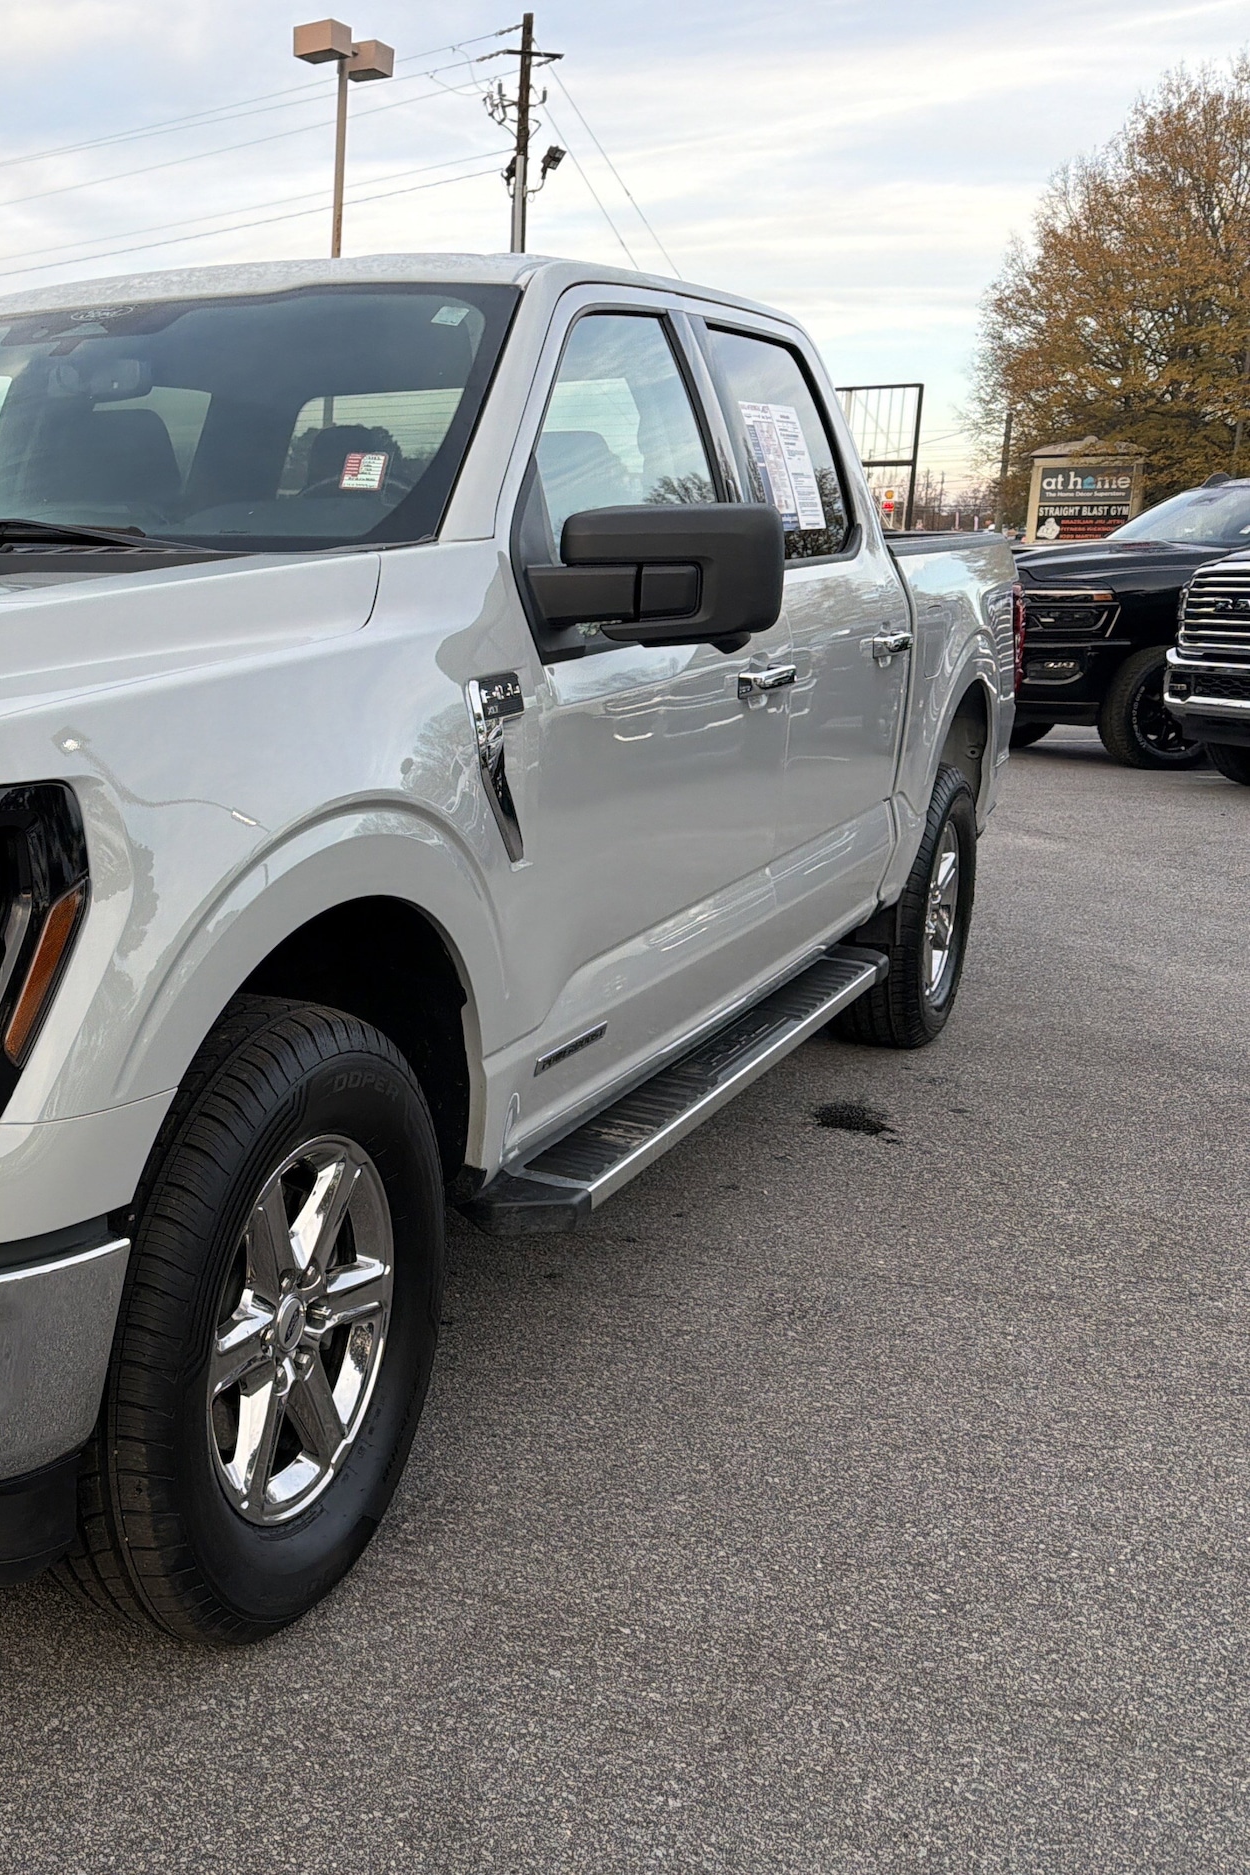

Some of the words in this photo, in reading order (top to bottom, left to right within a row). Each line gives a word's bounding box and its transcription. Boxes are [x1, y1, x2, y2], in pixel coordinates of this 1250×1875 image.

[1042, 474, 1065, 490] at
[1093, 490, 1126, 498] Superstore
[1038, 506, 1081, 517] STRAIGHT
[1081, 505, 1110, 516] BLAST
[1110, 505, 1130, 516] GYM
